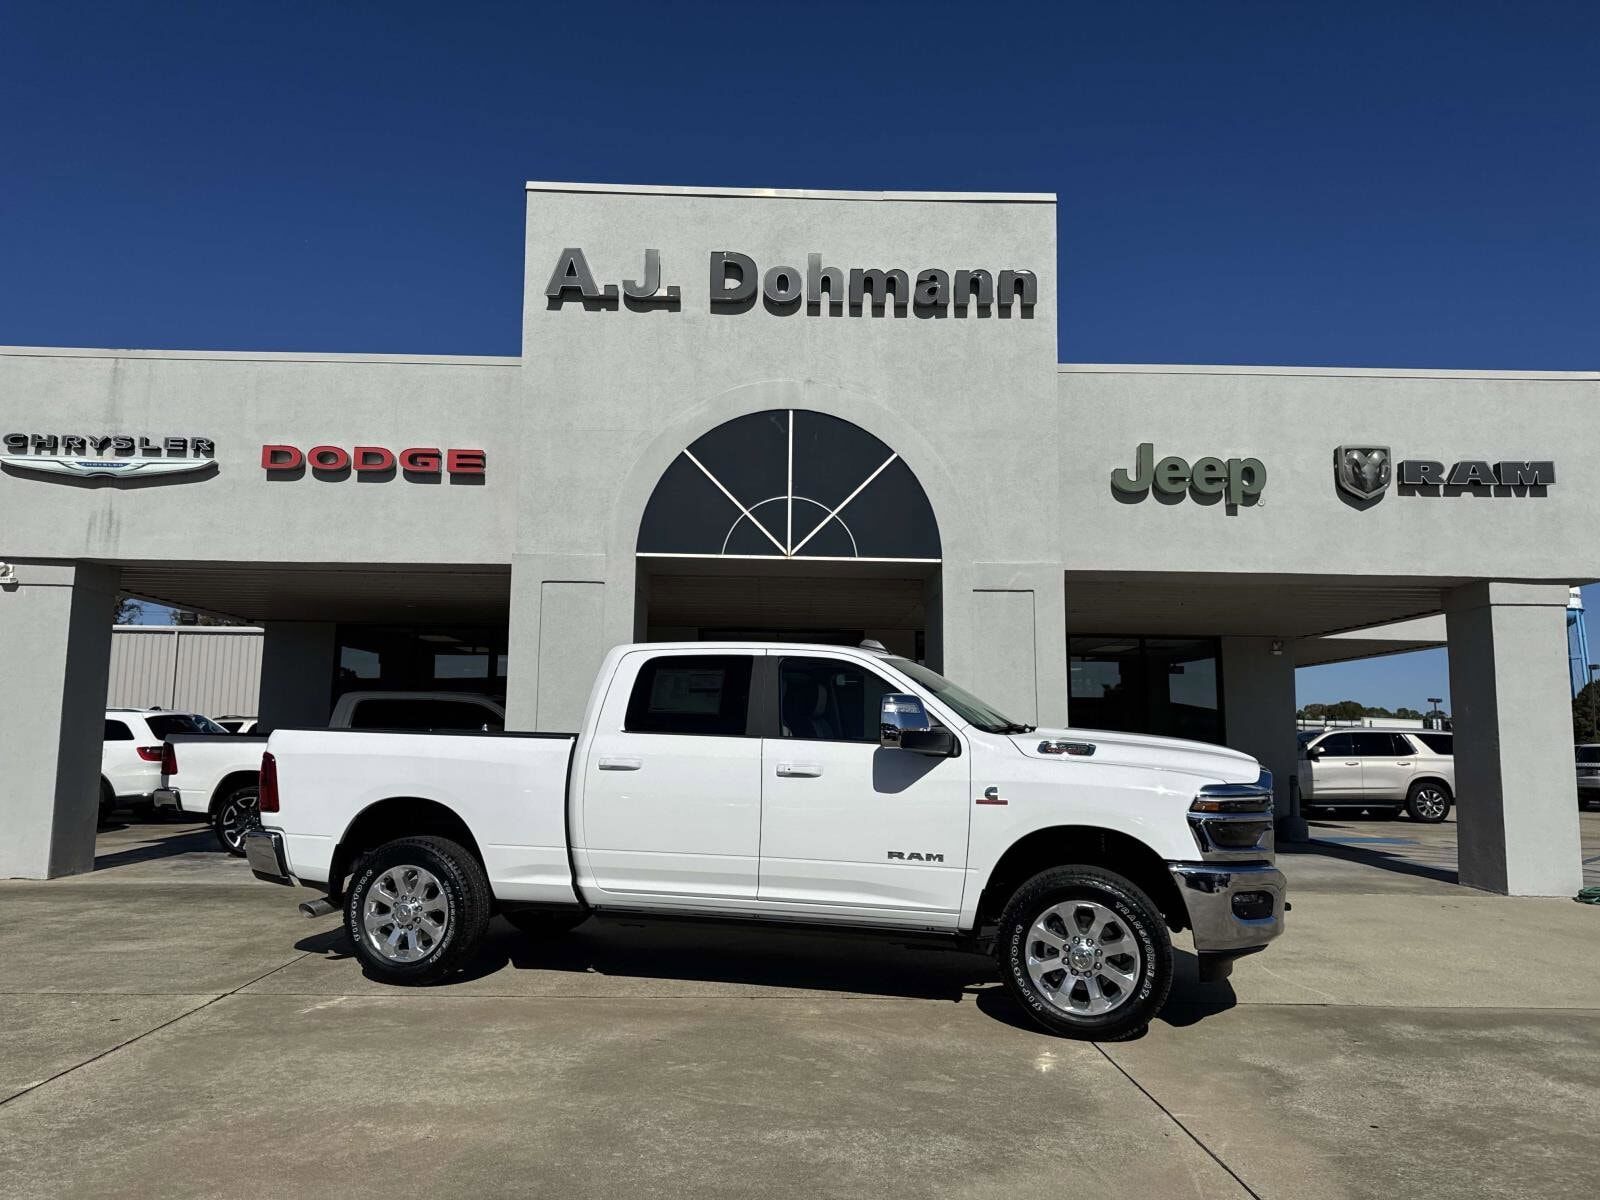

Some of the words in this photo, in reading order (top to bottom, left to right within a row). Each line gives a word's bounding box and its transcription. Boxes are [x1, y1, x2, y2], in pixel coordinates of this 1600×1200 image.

[544, 247, 682, 305] A.J.
[709, 250, 1038, 309] Dohmann
[3, 433, 215, 456] CHRYSLER
[261, 445, 486, 477] DODGE
[1111, 443, 1267, 509] Jeep
[1397, 460, 1556, 488] RAM
[888, 851, 944, 862] RAM
